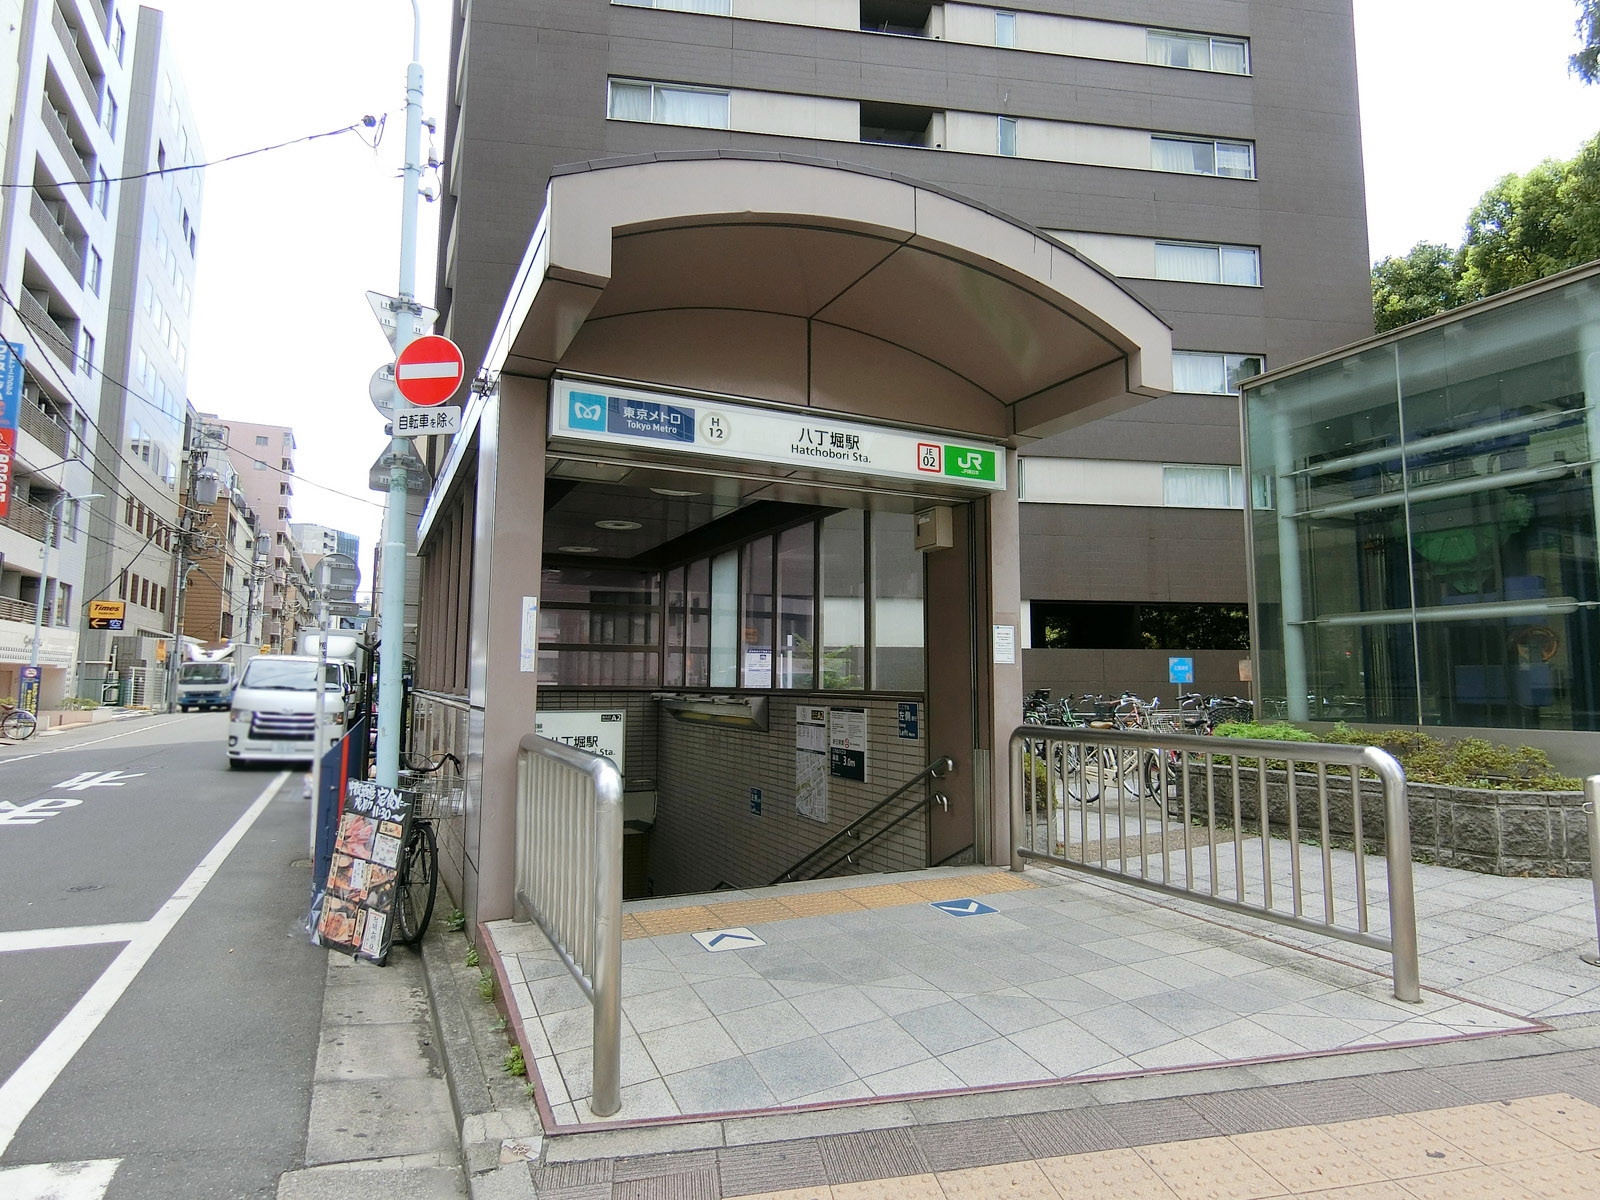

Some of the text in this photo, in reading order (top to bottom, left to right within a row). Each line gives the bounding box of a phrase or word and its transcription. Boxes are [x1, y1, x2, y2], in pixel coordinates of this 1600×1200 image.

[399, 412, 454, 430] 自転車を除く
[623, 406, 681, 424] 東京メトロ
[626, 419, 677, 434] Tokyo Metro
[711, 417, 720, 427] H
[709, 427, 723, 439] 12
[798, 427, 860, 450] 八丁堀駅
[791, 443, 872, 464] Hatchobori Sta.
[925, 447, 934, 456] JE
[922, 456, 936, 468] 02
[957, 452, 982, 470] JR
[94, 604, 120, 612] Times
[599, 748, 616, 757] Sta.
[842, 755, 856, 767] 3.0m
